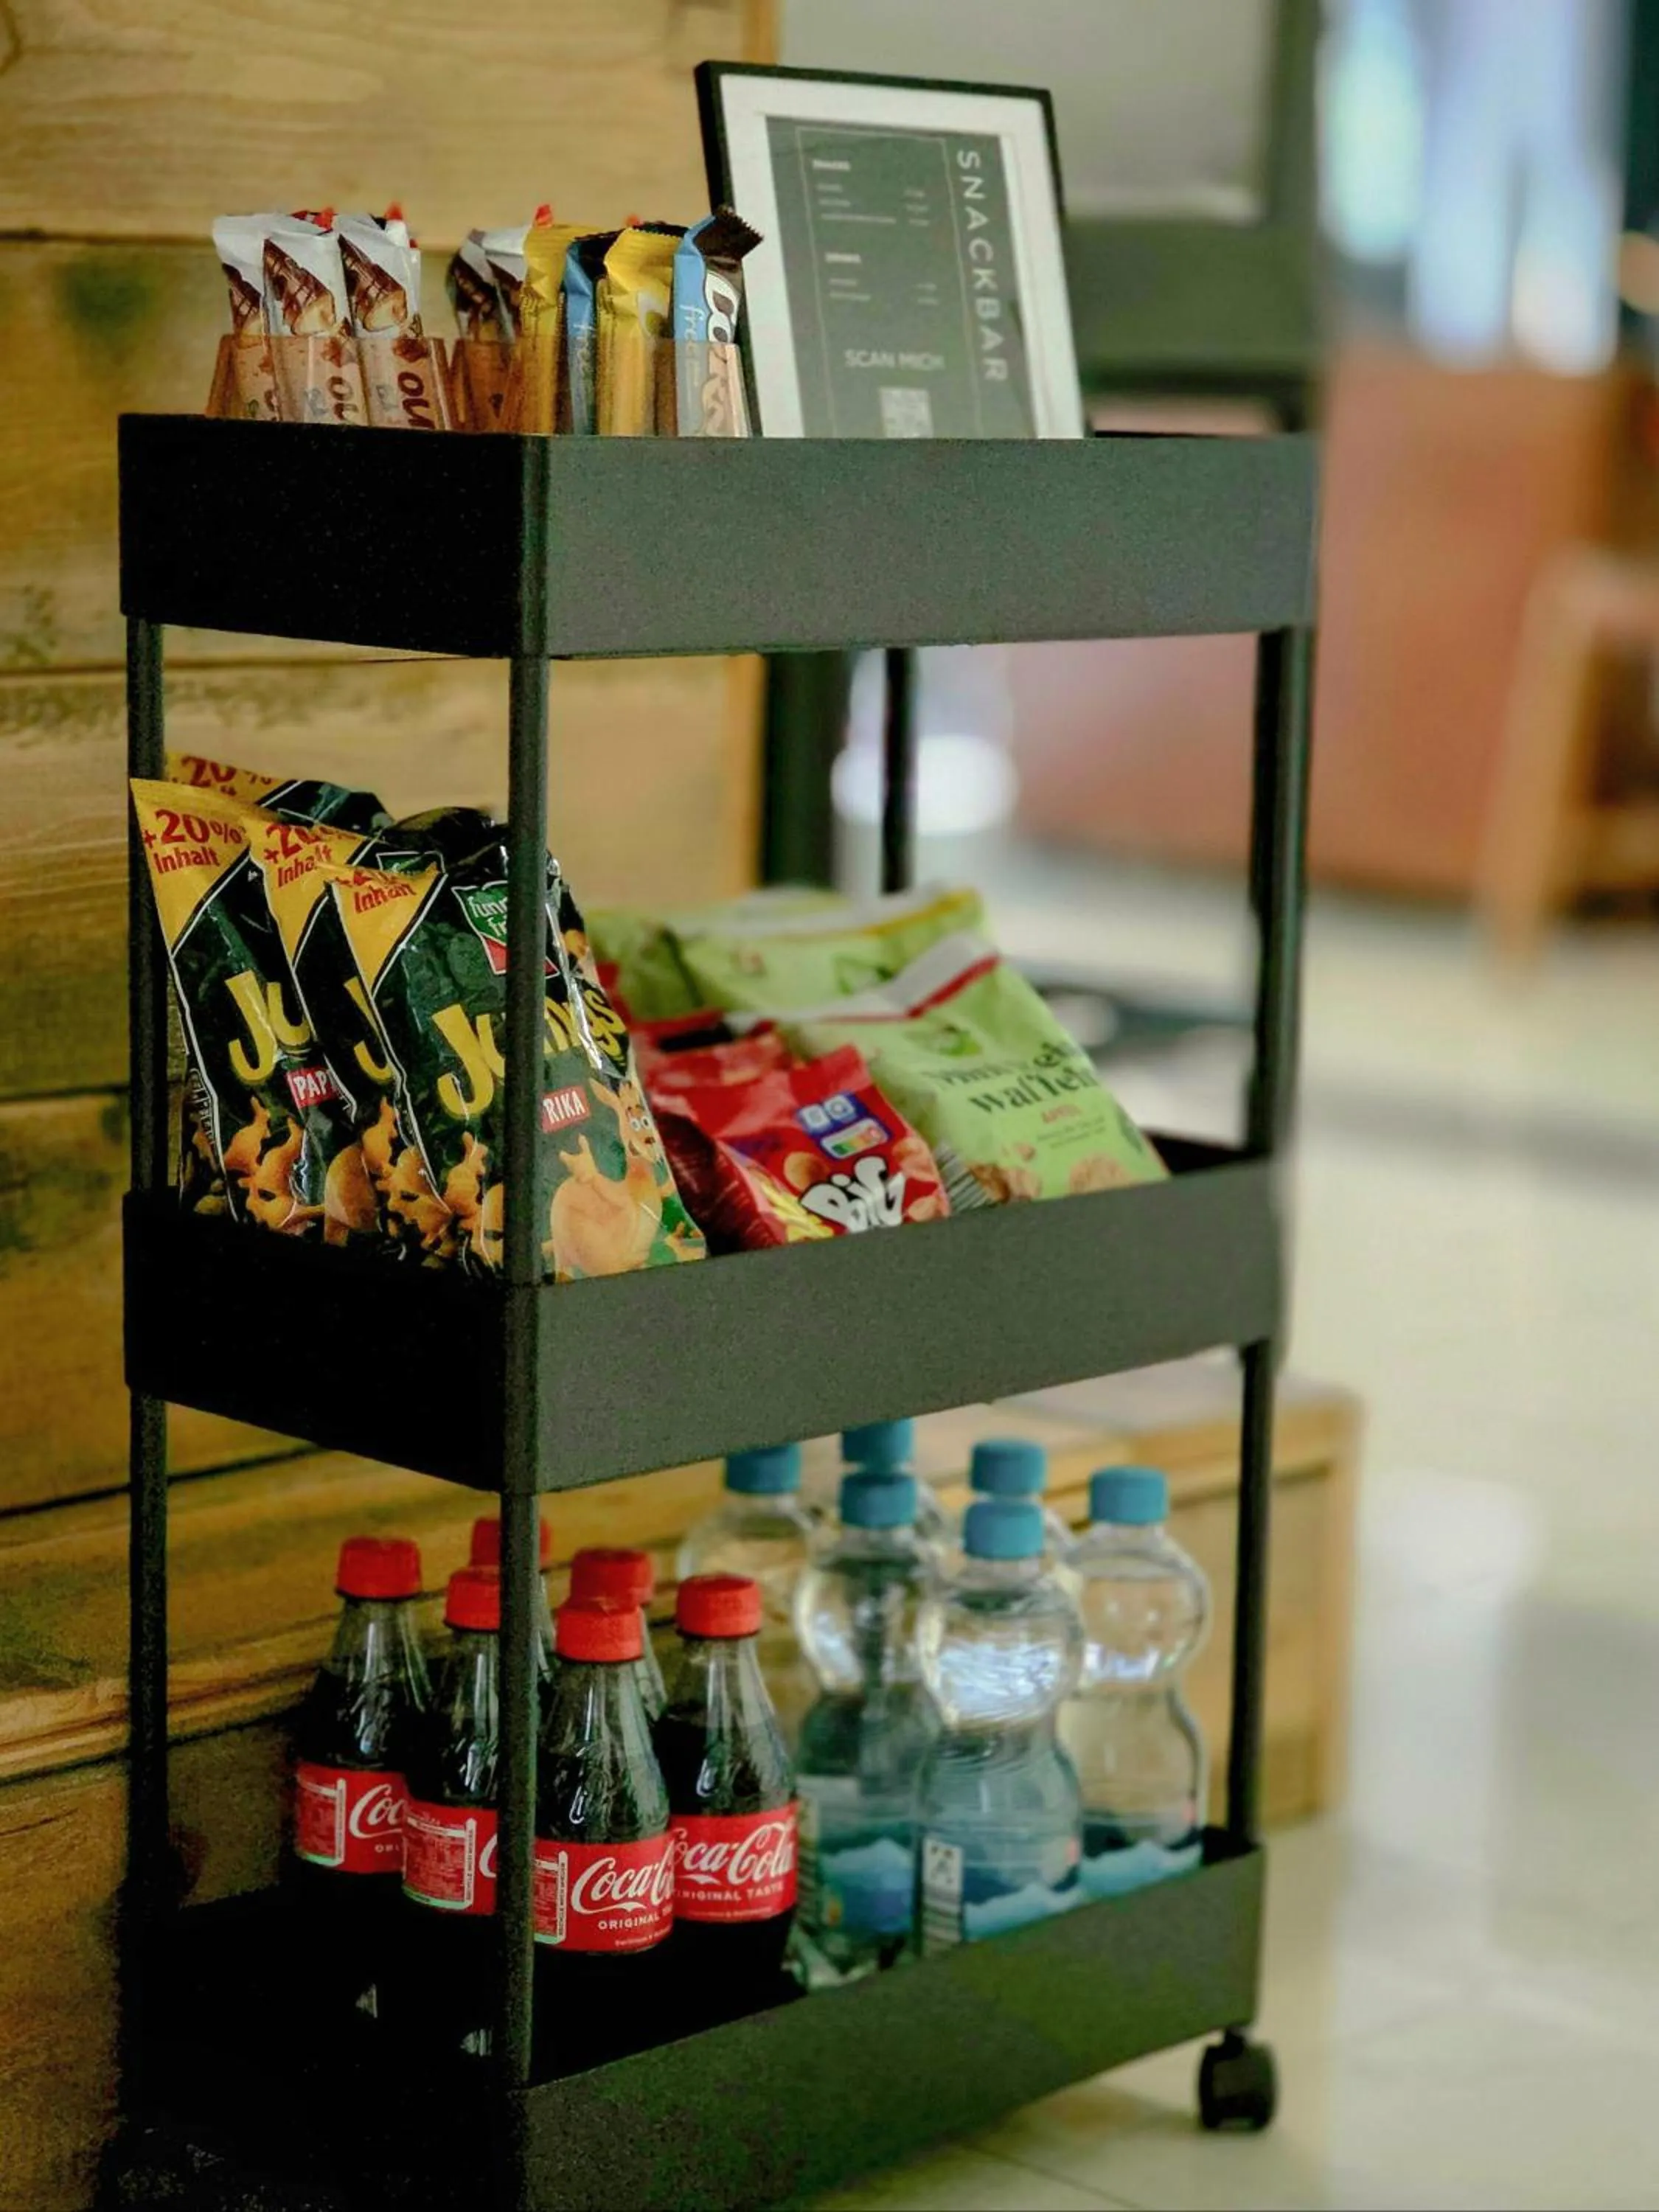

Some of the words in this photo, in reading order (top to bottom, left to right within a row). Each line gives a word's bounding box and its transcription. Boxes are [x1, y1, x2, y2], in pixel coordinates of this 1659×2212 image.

[957, 150, 1008, 380] SNACKBAR
[844, 349, 895, 368] SCAN
[153, 846, 220, 874] Inhalt
[543, 1091, 585, 1124] RIKA
[598, 1913, 660, 1930] ORIGINAL
